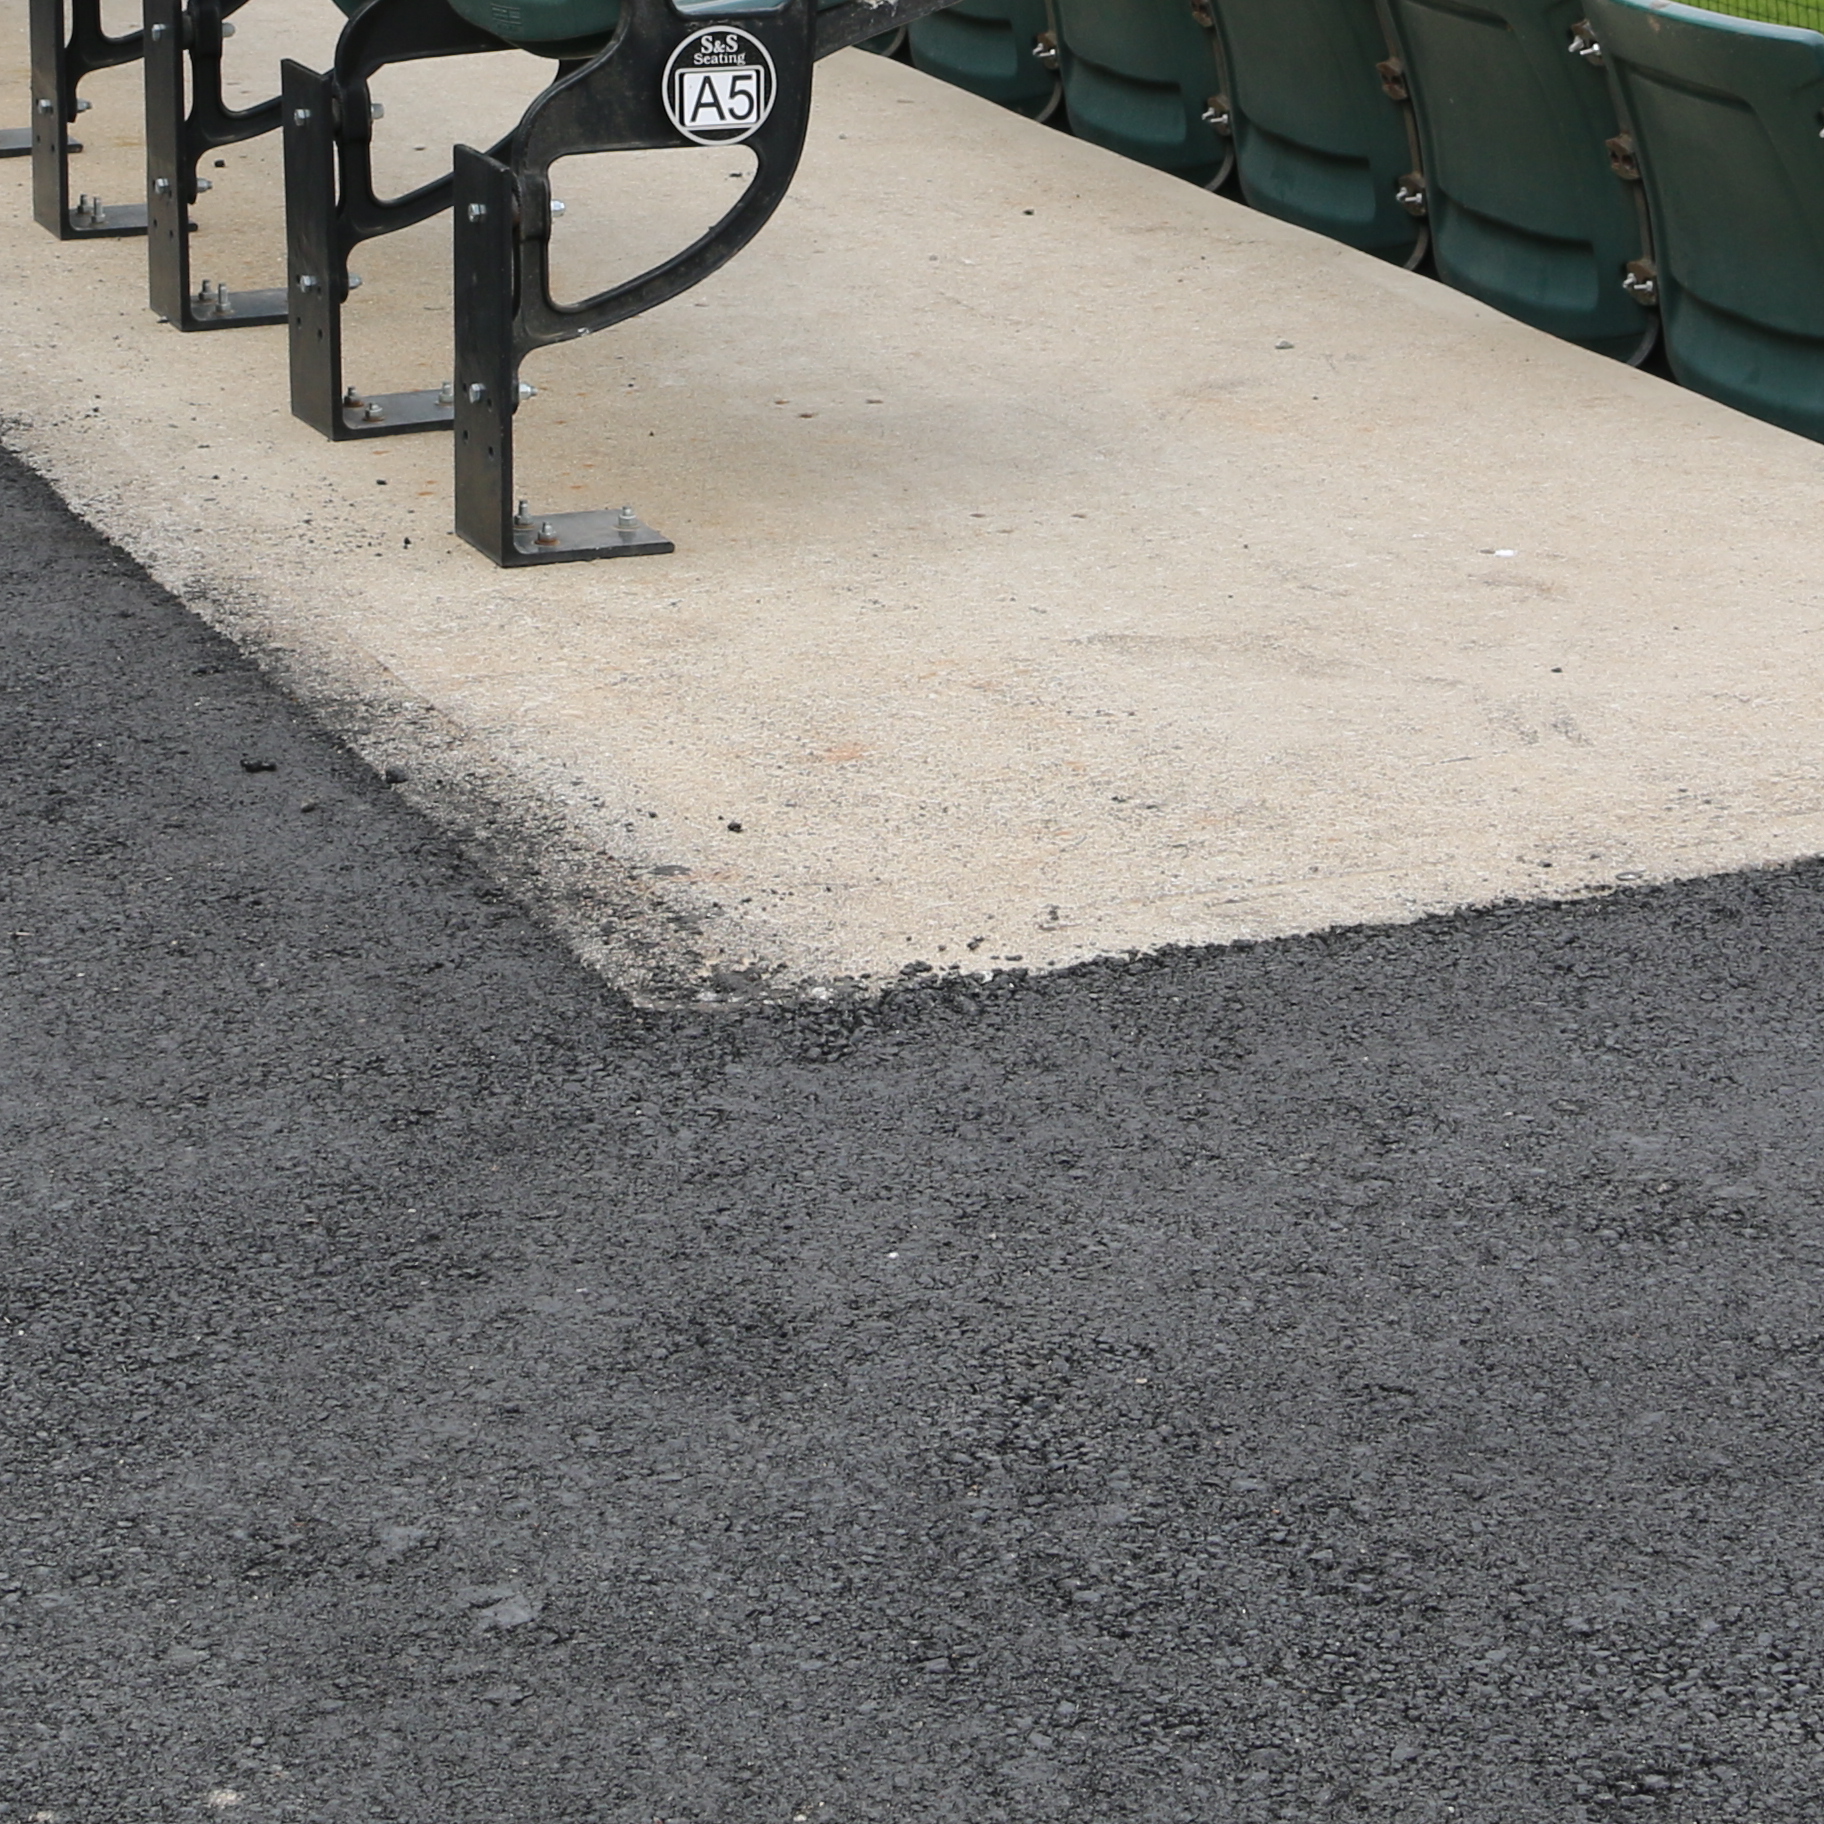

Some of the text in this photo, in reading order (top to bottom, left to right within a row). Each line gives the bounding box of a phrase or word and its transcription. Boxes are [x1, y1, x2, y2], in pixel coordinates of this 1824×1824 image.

[701, 34, 738, 54] S&S
[693, 52, 746, 66] Seating
[690, 74, 755, 123] A5
